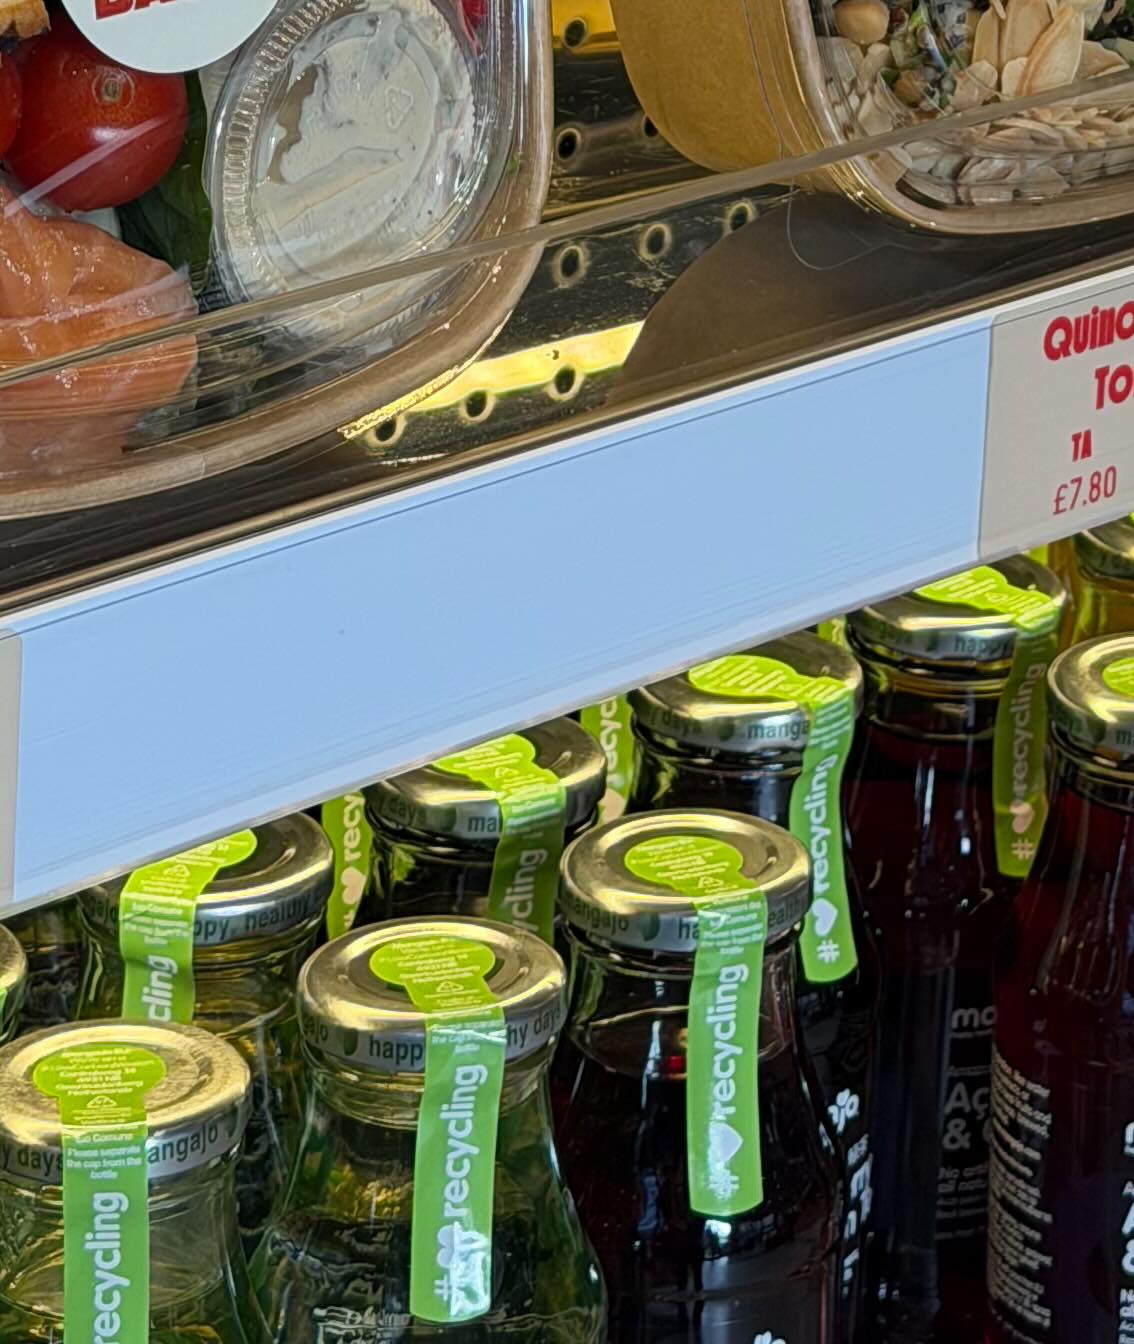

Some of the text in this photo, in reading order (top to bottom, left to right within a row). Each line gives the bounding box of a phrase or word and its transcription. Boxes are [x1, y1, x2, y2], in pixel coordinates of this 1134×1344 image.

[1072, 429, 1092, 462] TA
[1053, 465, 1118, 515] £7.80
[747, 717, 810, 741] manga
[1011, 663, 1047, 797] recycling
[804, 753, 838, 896] recycling
[141, 955, 178, 1023] cling
[368, 1035, 425, 1071] happ
[706, 963, 749, 1125] recycling
[147, 1123, 218, 1164] angajo
[440, 1063, 488, 1218] recycling
[84, 1191, 130, 1344] recycling
